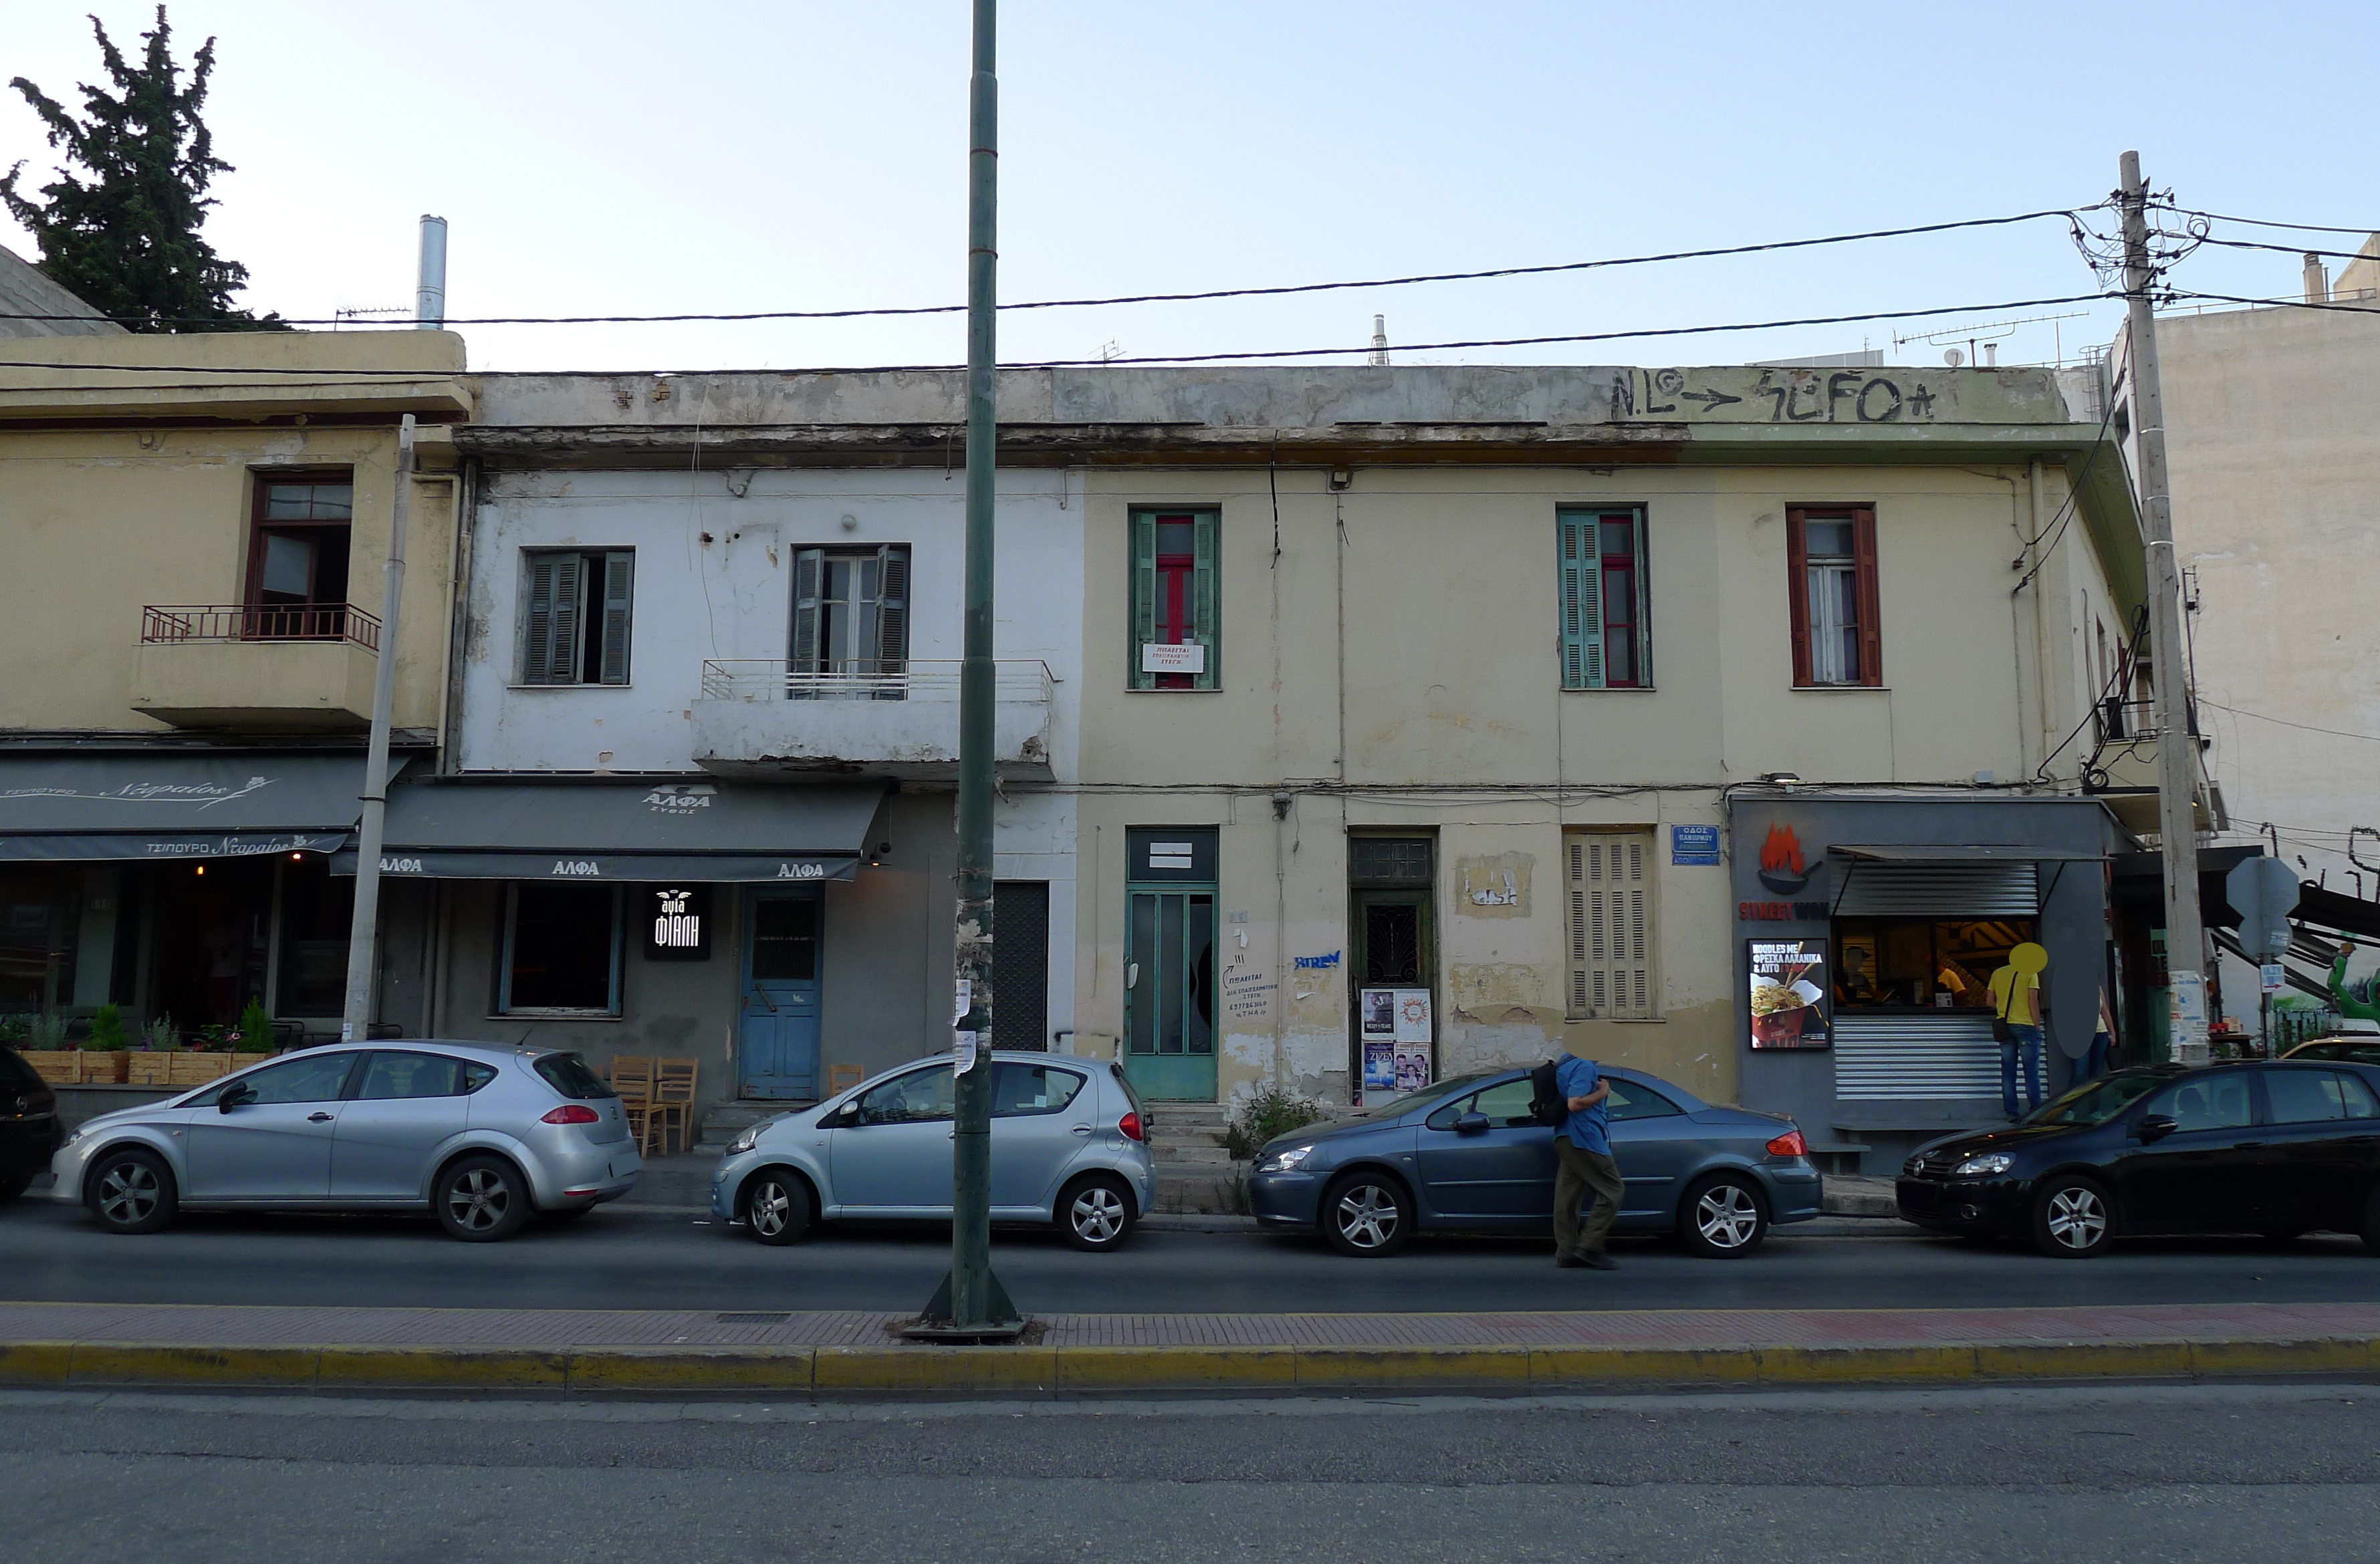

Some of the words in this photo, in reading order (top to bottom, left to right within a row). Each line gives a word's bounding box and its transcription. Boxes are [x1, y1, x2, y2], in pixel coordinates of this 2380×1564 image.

[642, 793, 710, 807] ΑΛΦΑ
[650, 806, 696, 814] ΖΥΘΟΣ
[146, 843, 209, 853] ΤΣΙΠΟΥΡΟ
[379, 858, 423, 872] ΑΛΦΑ
[552, 861, 600, 875] ΑΛΦΑ
[778, 864, 824, 877] ΑΛΦΑ
[655, 916, 699, 946] ΦΙΑΛΗ
[1752, 944, 1786, 954] NOODLES
[1753, 954, 1784, 963] ΦΡΕΣΚΑ
[1784, 954, 1823, 963] ΛΑΧΑΝΙΚΑ
[1761, 964, 1780, 973] ΑΥΓΟ
[1229, 974, 1262, 985] ΠΩΛΕΙΤΑΙ
